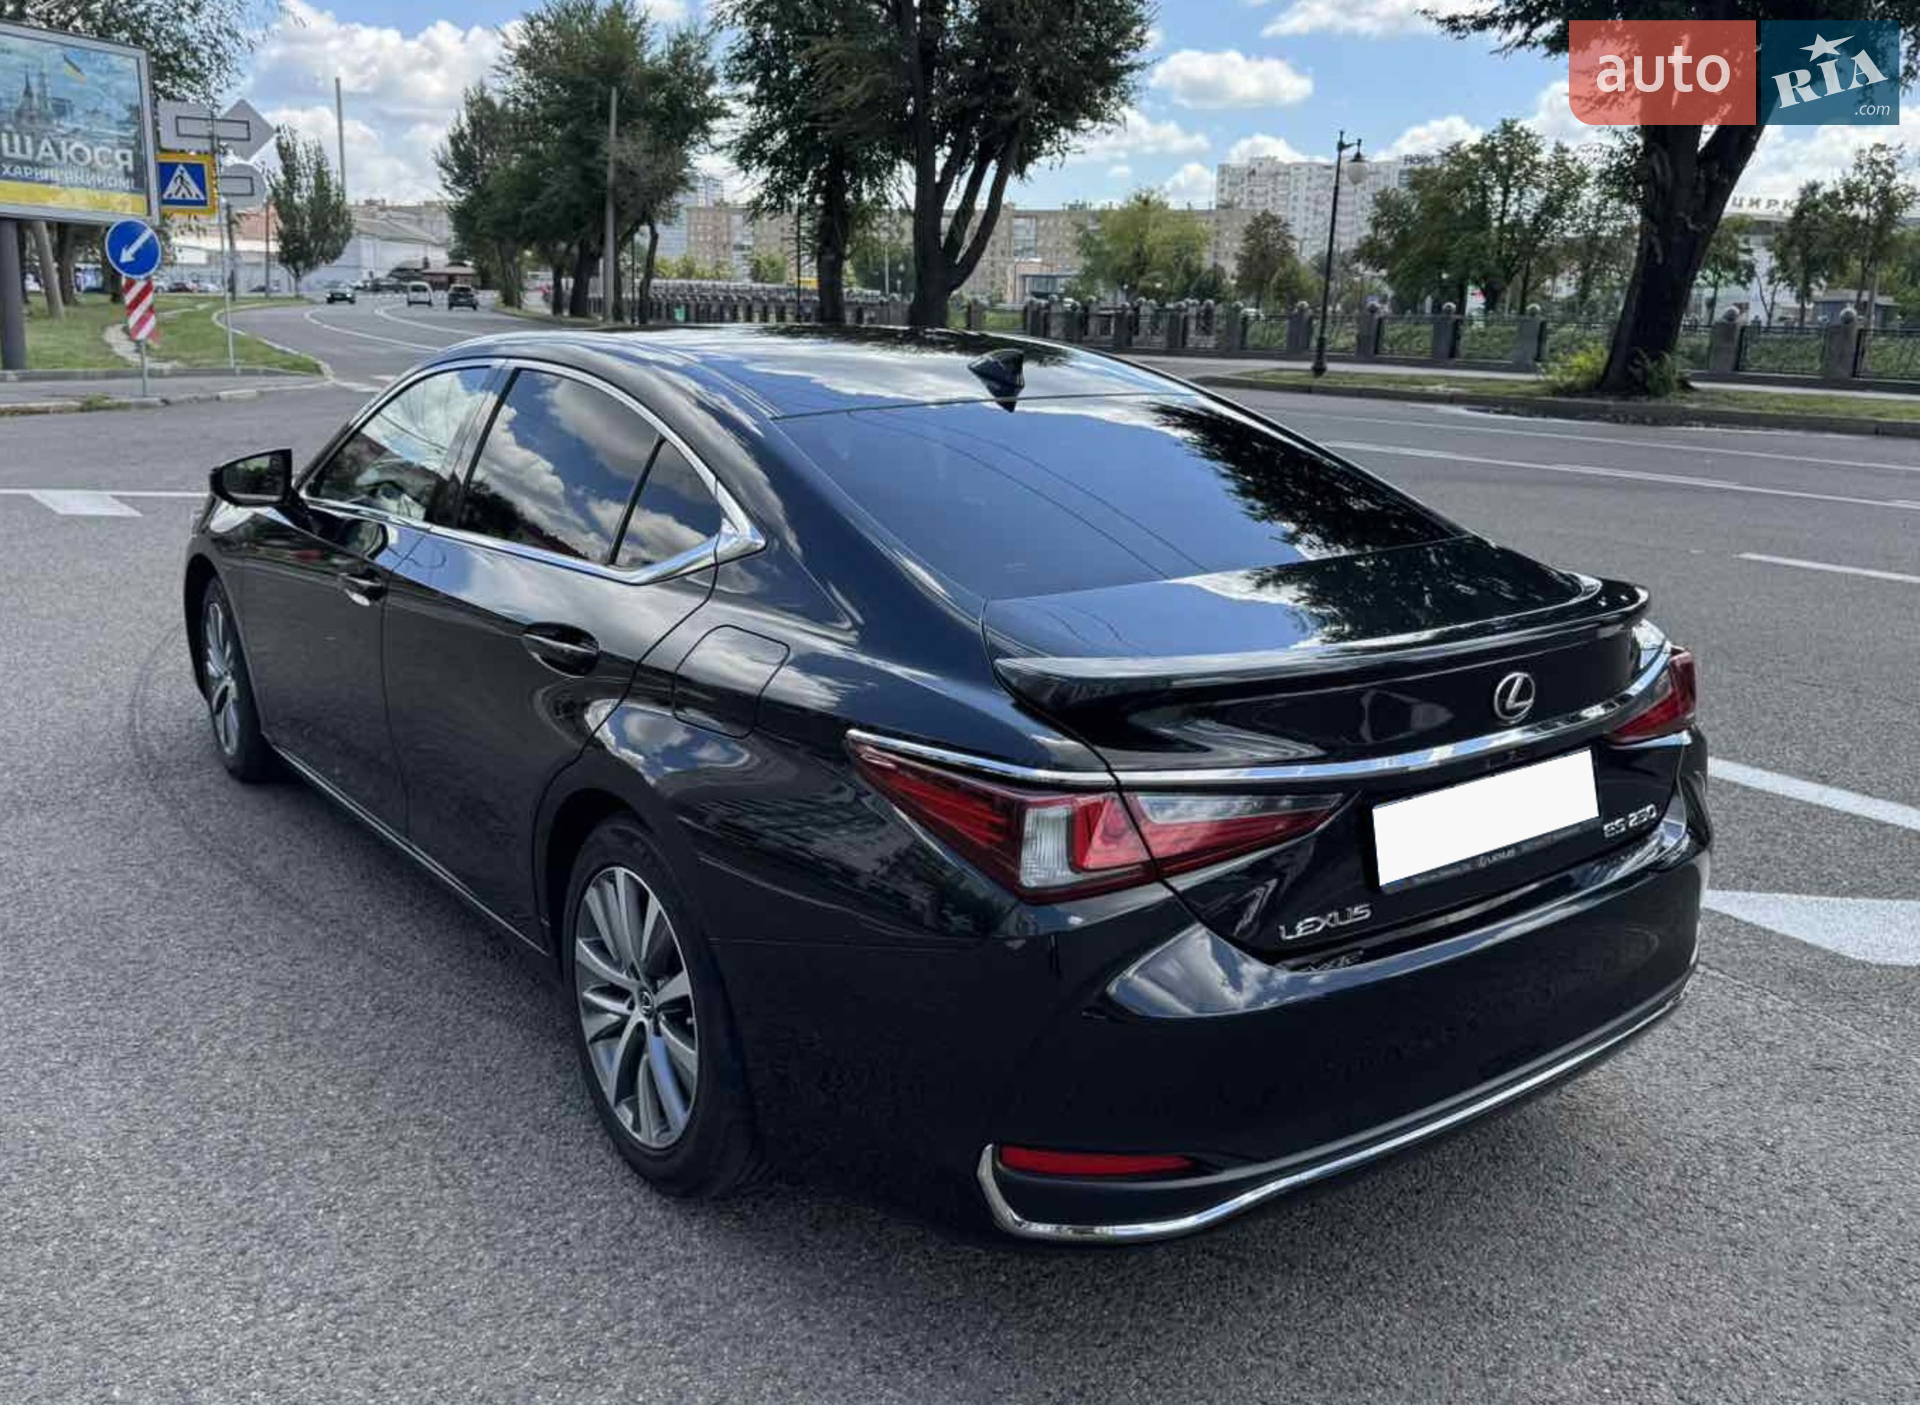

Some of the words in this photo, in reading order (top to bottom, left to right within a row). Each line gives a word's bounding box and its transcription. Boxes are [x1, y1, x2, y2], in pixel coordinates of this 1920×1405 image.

[1731, 196, 1796, 211] ЦИРК
[1603, 817, 1626, 838] ES
[1278, 903, 1372, 940] LEXUS
